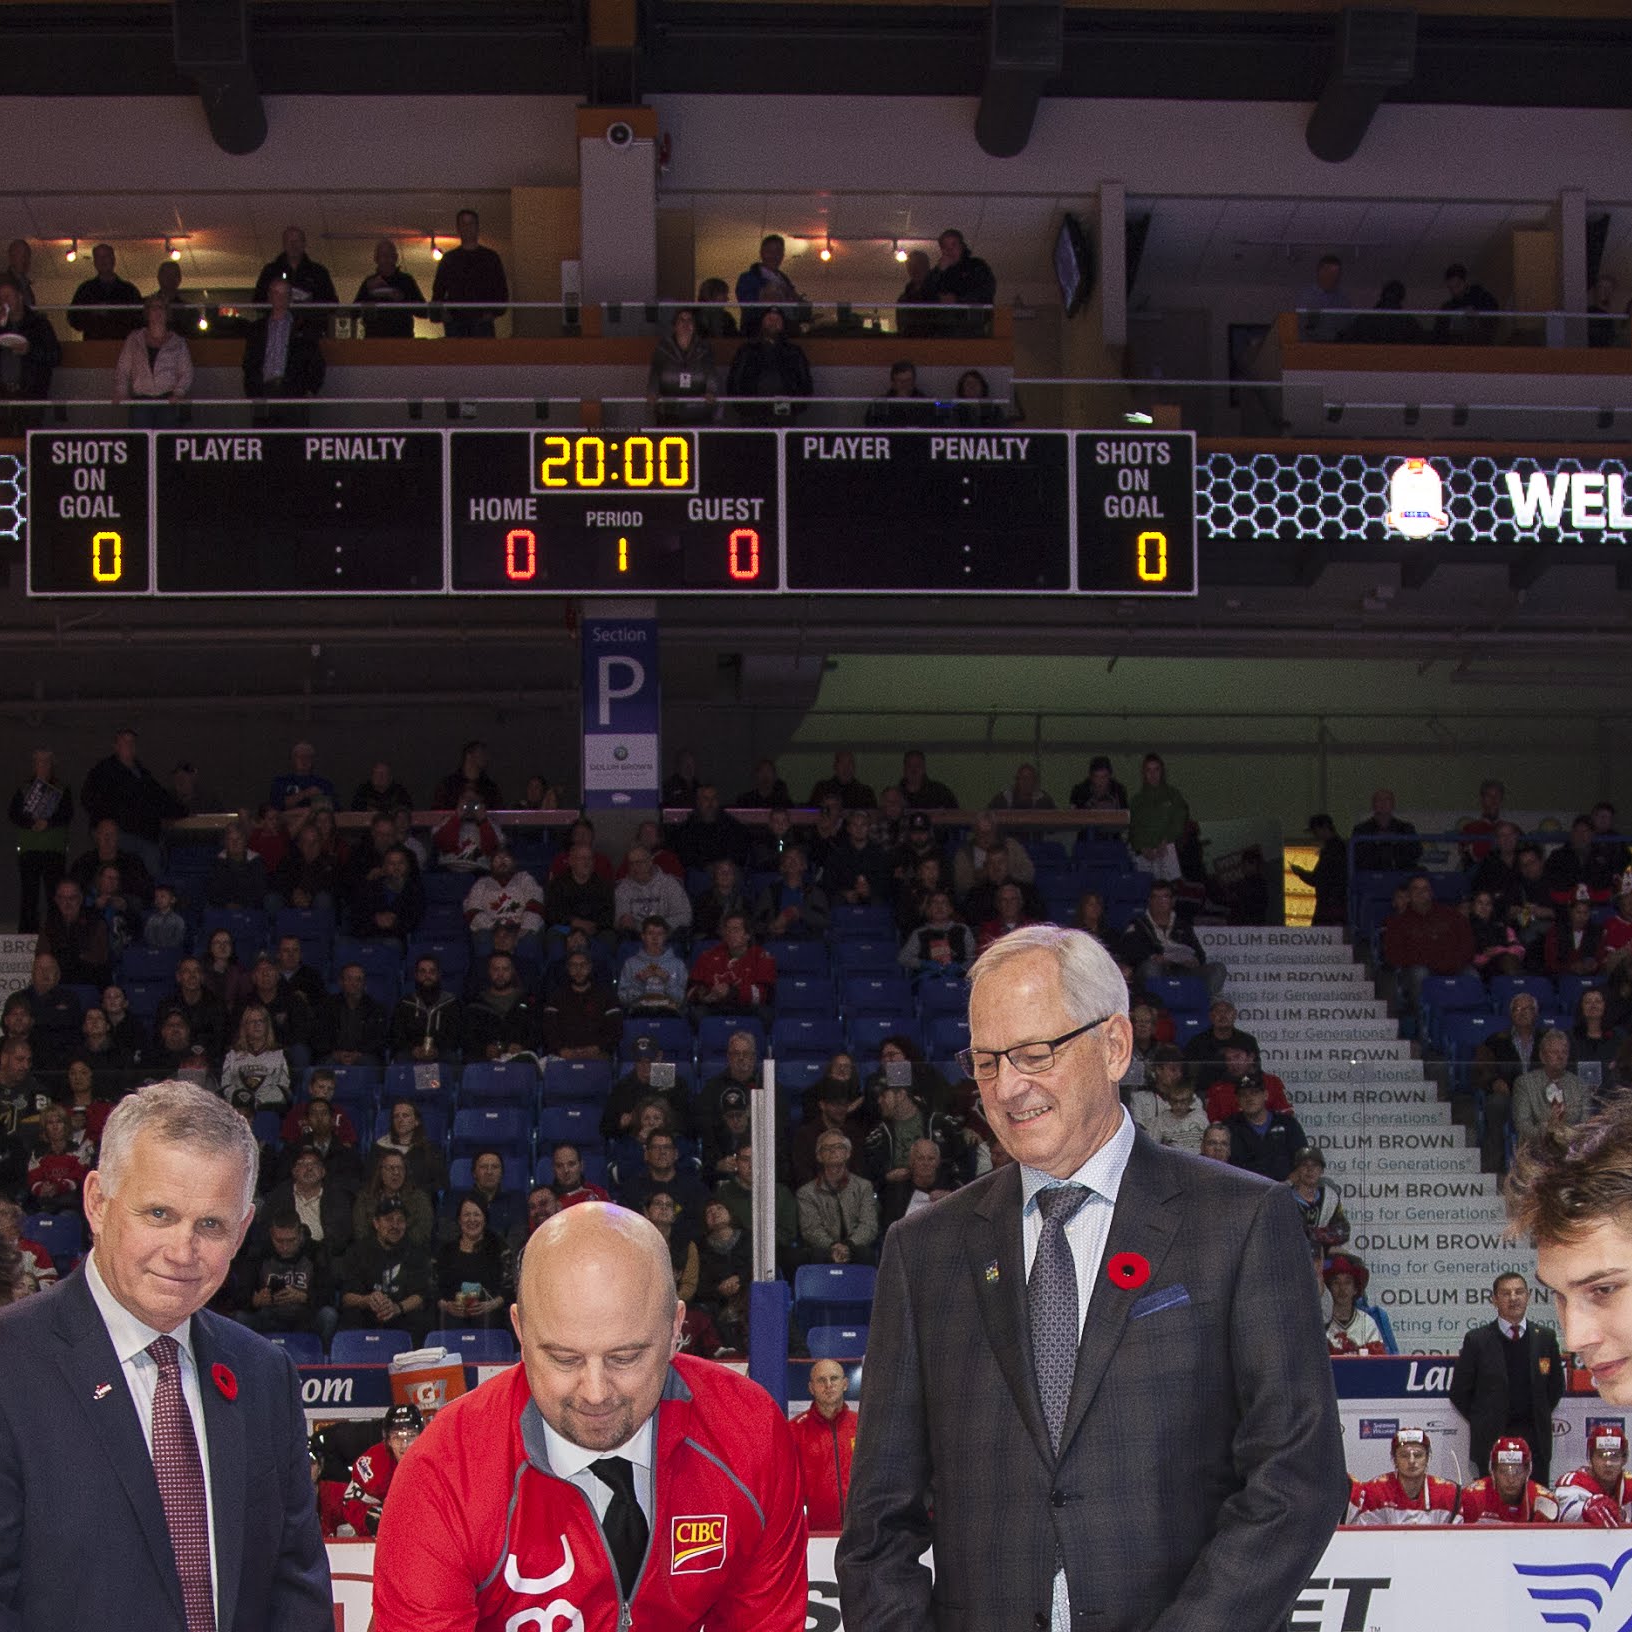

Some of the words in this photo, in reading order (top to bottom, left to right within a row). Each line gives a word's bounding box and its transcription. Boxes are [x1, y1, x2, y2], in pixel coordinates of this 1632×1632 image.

[52, 441, 127, 465] SHOTS
[175, 439, 263, 461] PLAYER
[305, 438, 406, 461] PENALTY
[803, 438, 891, 460] PLAYER
[931, 438, 1030, 461] PENALTY
[1096, 442, 1171, 465] SHOTS
[541, 436, 689, 487] 20:00
[74, 468, 105, 492] ON
[1117, 469, 1150, 491] ON
[59, 496, 120, 519] GOAL
[469, 498, 537, 521] HOME
[586, 511, 643, 527] PERIOD
[688, 498, 764, 521] GUEST
[1104, 496, 1164, 519] GOAL
[92, 531, 121, 582] 0
[505, 529, 536, 580] 0
[618, 537, 627, 572] 1
[729, 528, 759, 579] 0
[1138, 531, 1167, 581] 0
[592, 627, 647, 642] Section
[597, 655, 645, 725] P
[2, 939, 39, 954] BRO
[1203, 933, 1262, 946] ODLUM
[1268, 933, 1333, 946] BROWN
[1308, 1008, 1376, 1020] BROWN
[1353, 1090, 1426, 1104] BROWN
[1352, 1112, 1438, 1125] Generations
[1306, 1134, 1372, 1149] ODLUM
[1379, 1134, 1454, 1149] BROWN
[1352, 1157, 1373, 1171] for
[1378, 1157, 1466, 1171] Generations
[1406, 1183, 1484, 1198] BROWN
[1379, 1207, 1400, 1222] for
[1406, 1207, 1497, 1222] Generations
[1354, 1234, 1429, 1250] ODLUM
[1436, 1234, 1517, 1250] BROWN
[1406, 1259, 1429, 1276] for
[1434, 1259, 1529, 1276] Generations
[1380, 1288, 1458, 1305] ODLUM
[1437, 1315, 1460, 1332] for
[676, 1521, 722, 1544] CIBC
